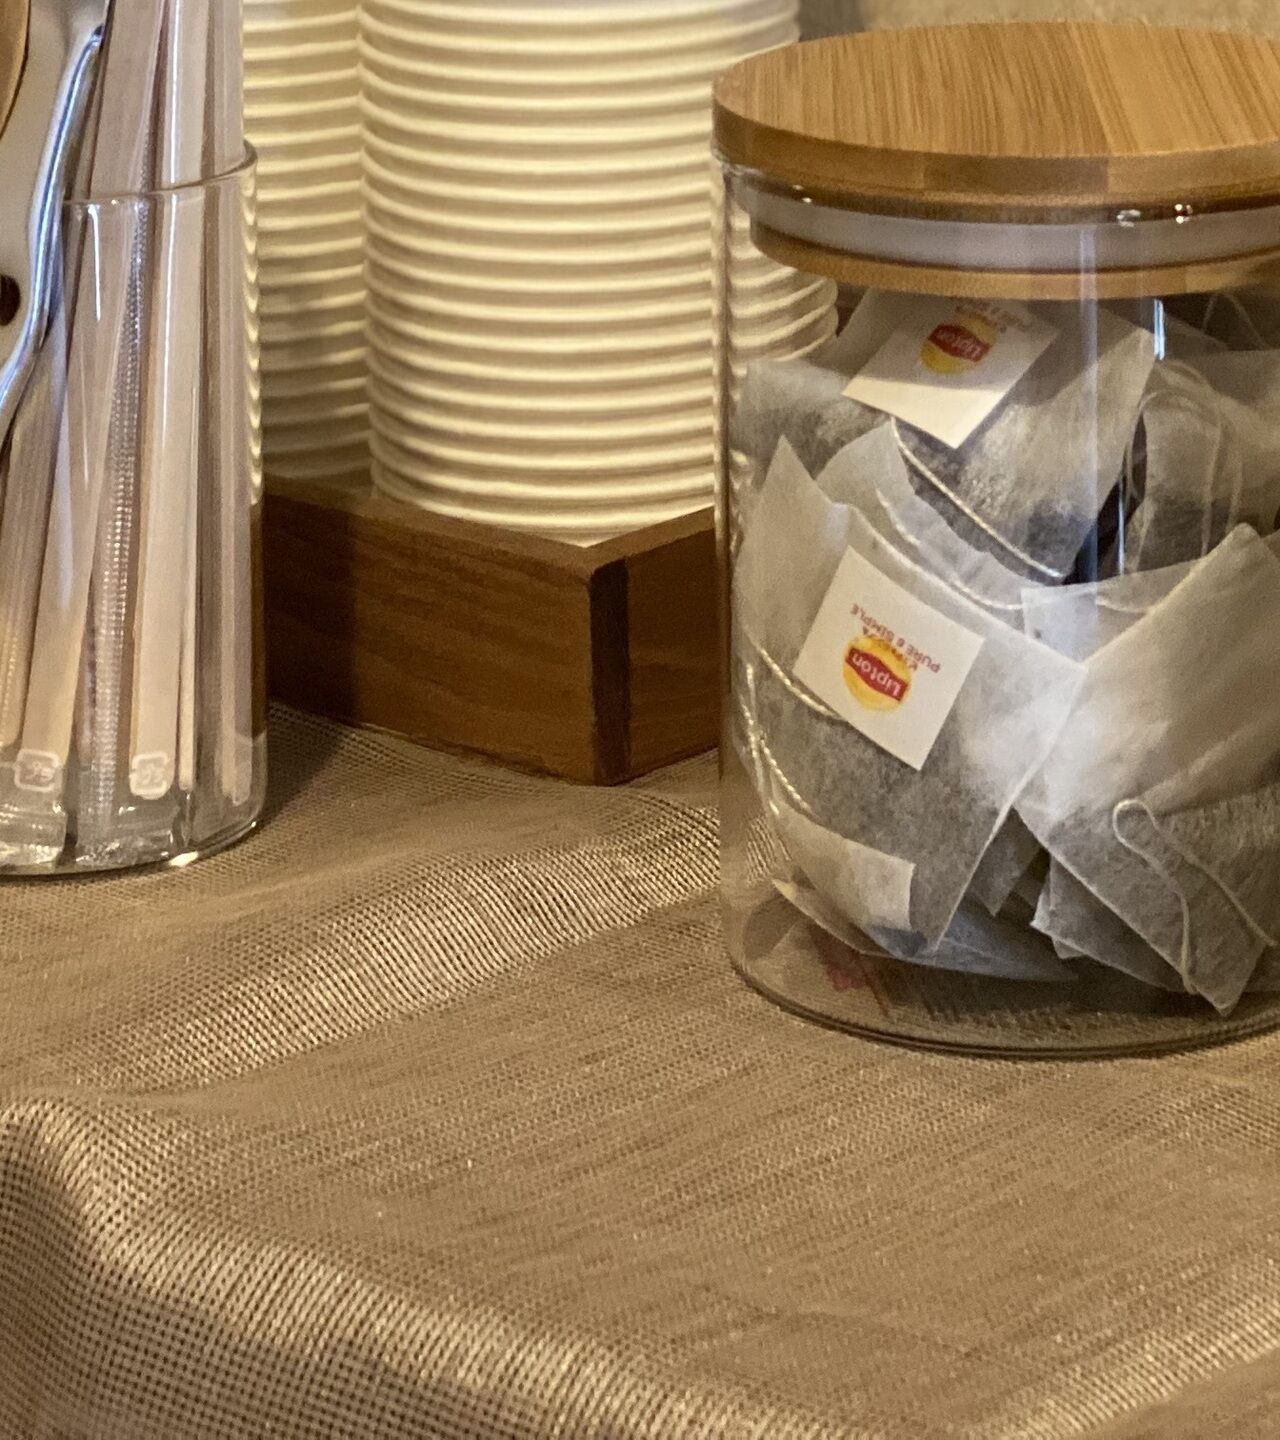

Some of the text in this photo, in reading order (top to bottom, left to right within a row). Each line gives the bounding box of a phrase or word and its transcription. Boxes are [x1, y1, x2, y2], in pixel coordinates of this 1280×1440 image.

[850, 603, 896, 643] SIMPLE
[852, 652, 902, 697] Lipton
[906, 644, 941, 674] PURE
